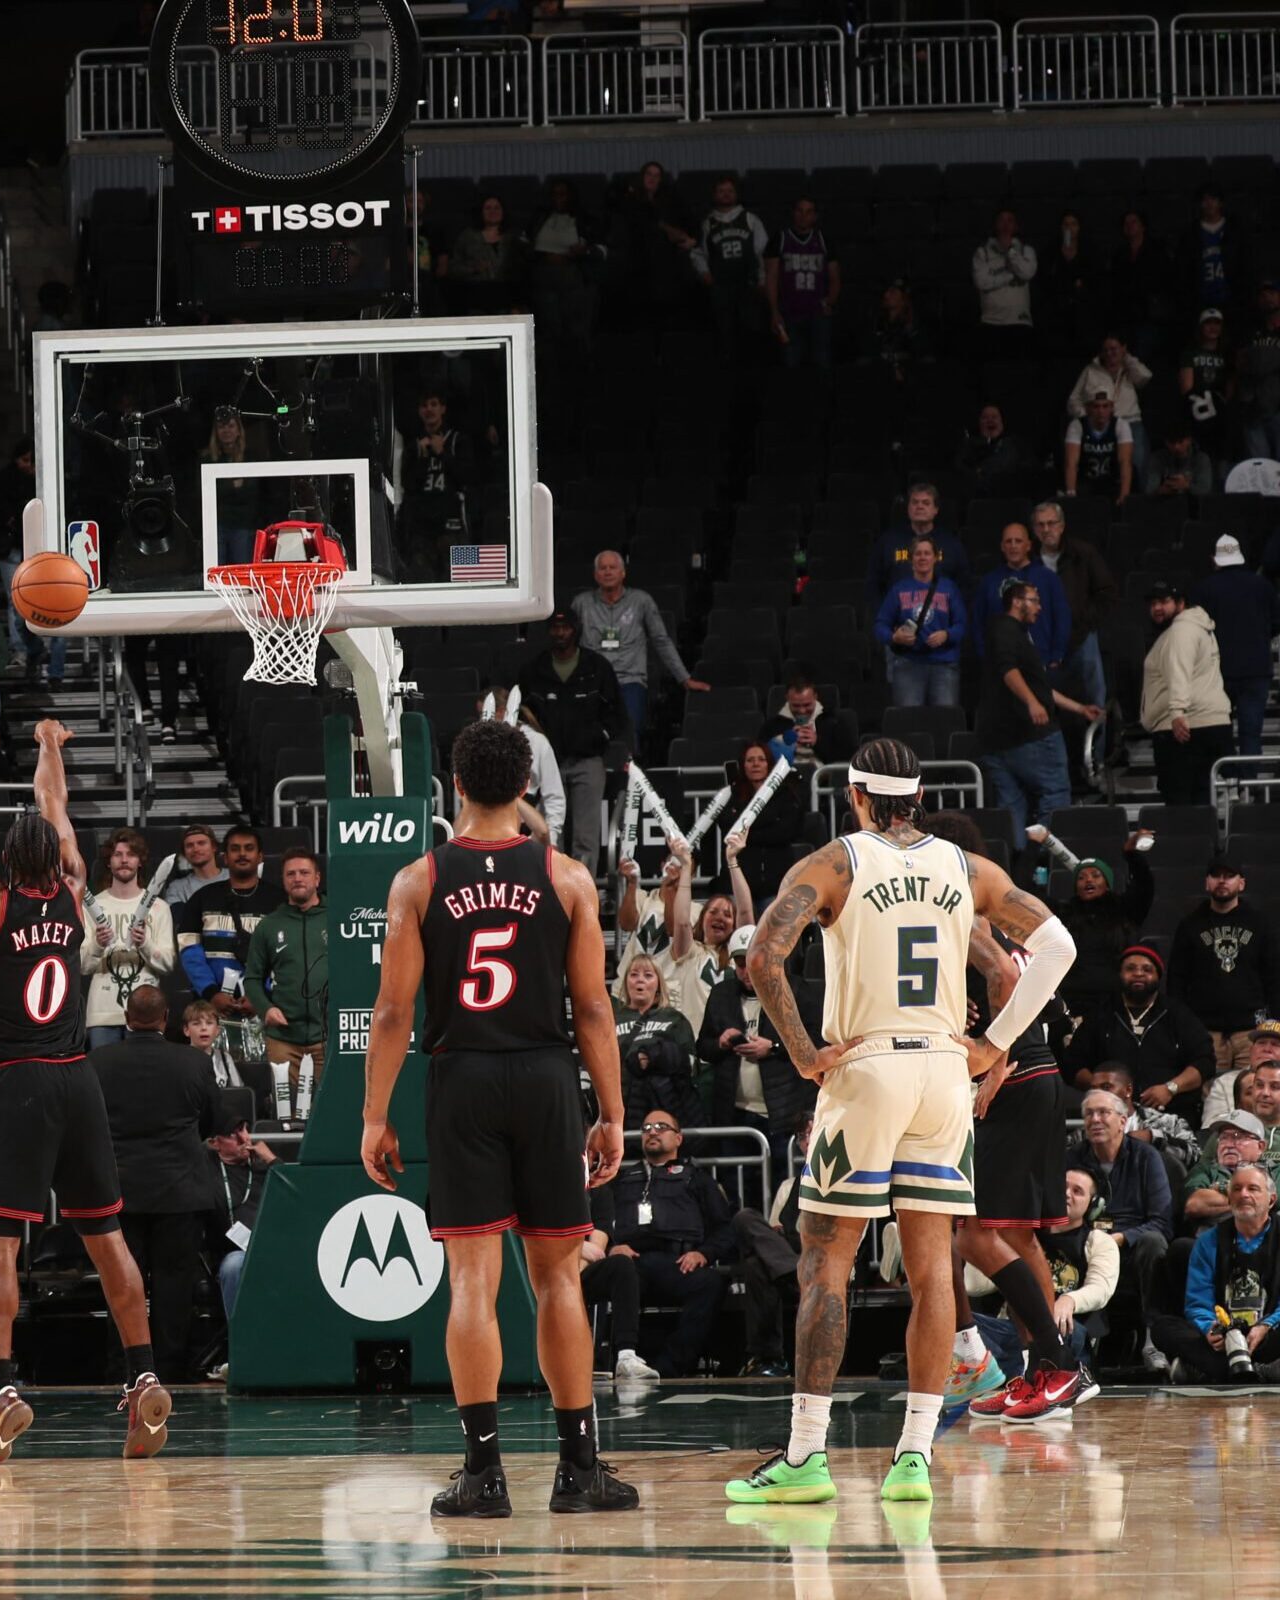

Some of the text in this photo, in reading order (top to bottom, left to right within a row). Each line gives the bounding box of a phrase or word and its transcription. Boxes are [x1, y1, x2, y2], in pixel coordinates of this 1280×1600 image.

[245, 200, 390, 232] TISSOT
[339, 812, 416, 844] wilo
[443, 881, 541, 920] GRIMES
[863, 876, 962, 915] TRENT JR
[349, 907, 388, 921] Miche
[11, 921, 74, 952] MAXEY
[340, 923, 388, 939] ULT
[459, 922, 518, 1012] 5
[898, 926, 938, 1008] 5
[23, 954, 69, 1025] 0
[339, 1013, 376, 1031] BUC
